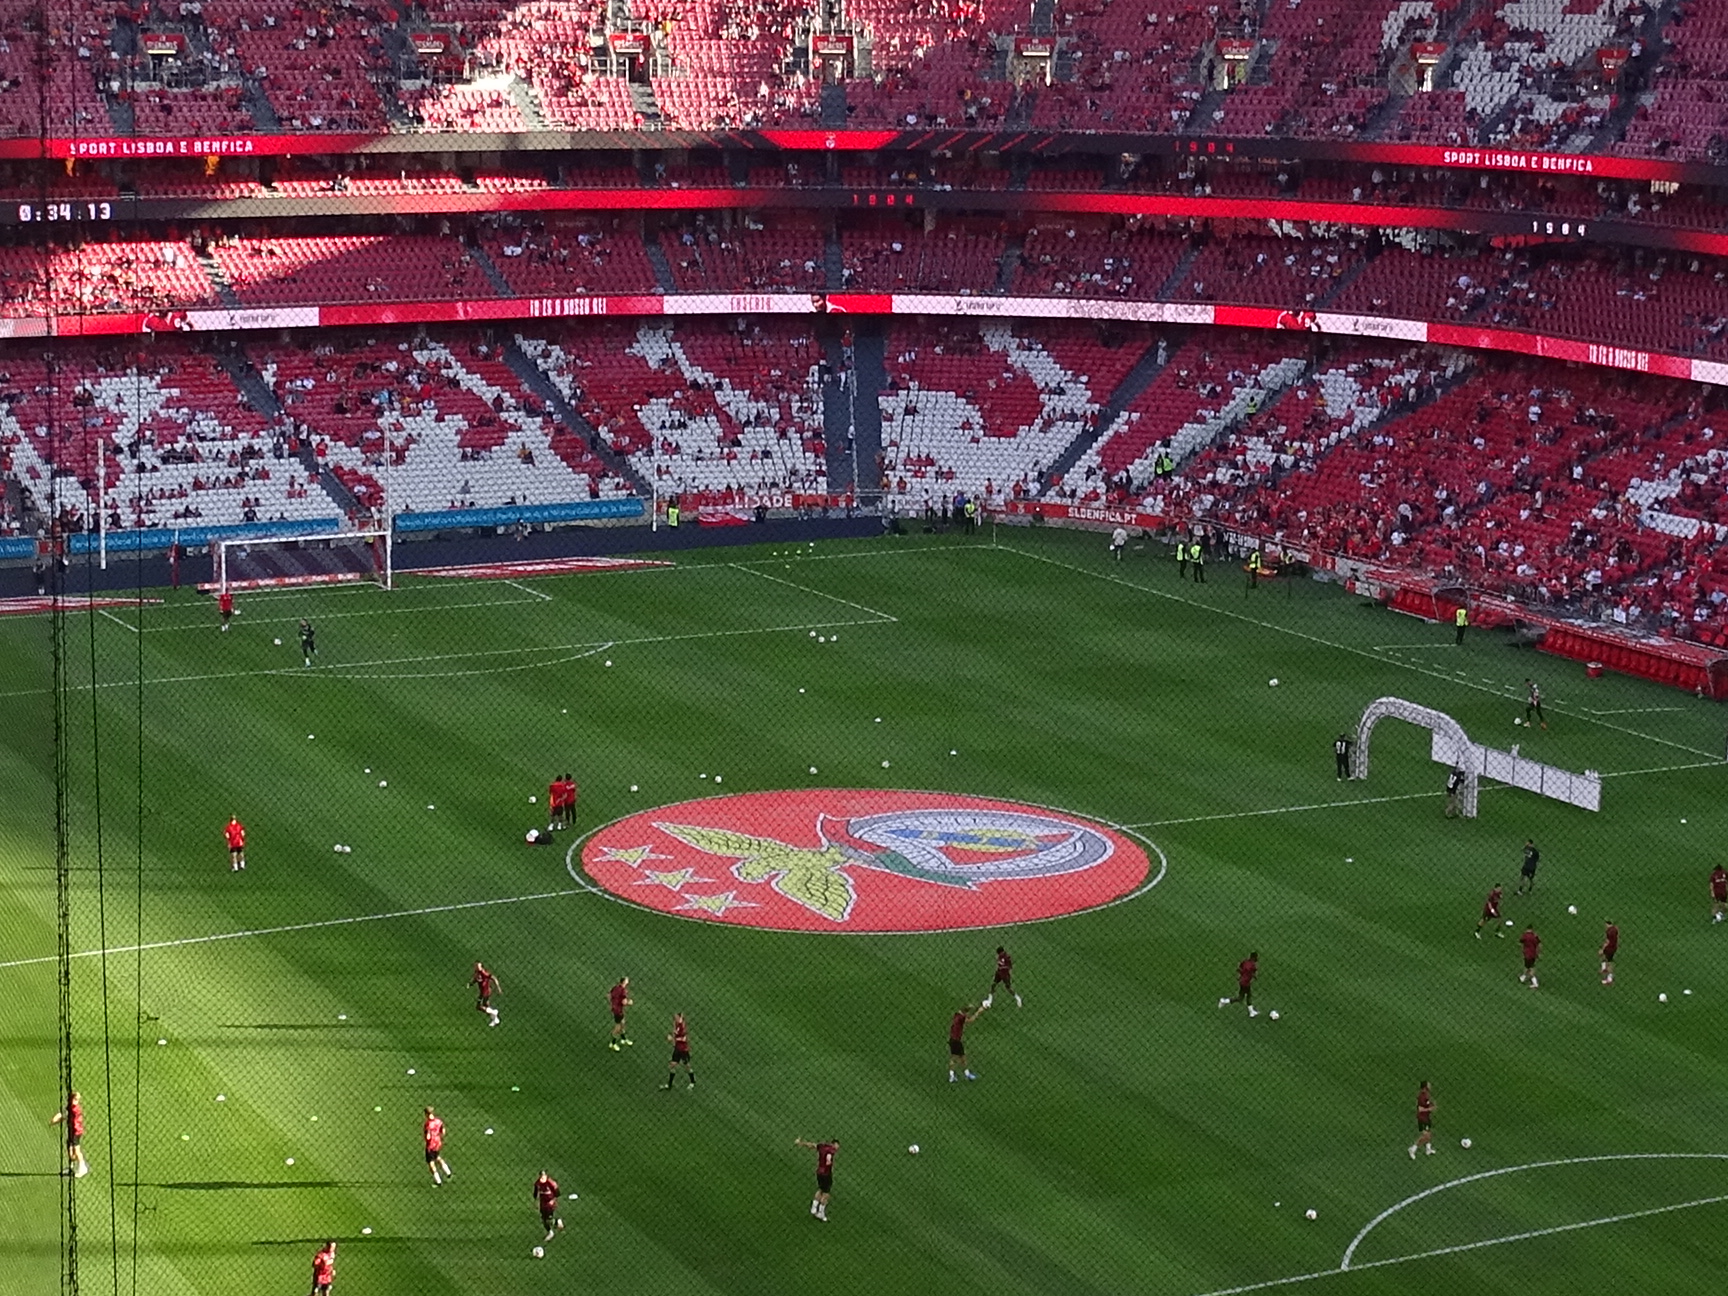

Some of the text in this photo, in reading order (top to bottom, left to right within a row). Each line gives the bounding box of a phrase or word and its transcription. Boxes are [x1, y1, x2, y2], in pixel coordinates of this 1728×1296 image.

[123, 141, 174, 154] LISBOA
[180, 141, 188, 154] E
[194, 140, 254, 154] BENFICA
[1443, 150, 1593, 172] SPORT LISBOA E BENFICA
[19, 202, 111, 222] 0:34:13
